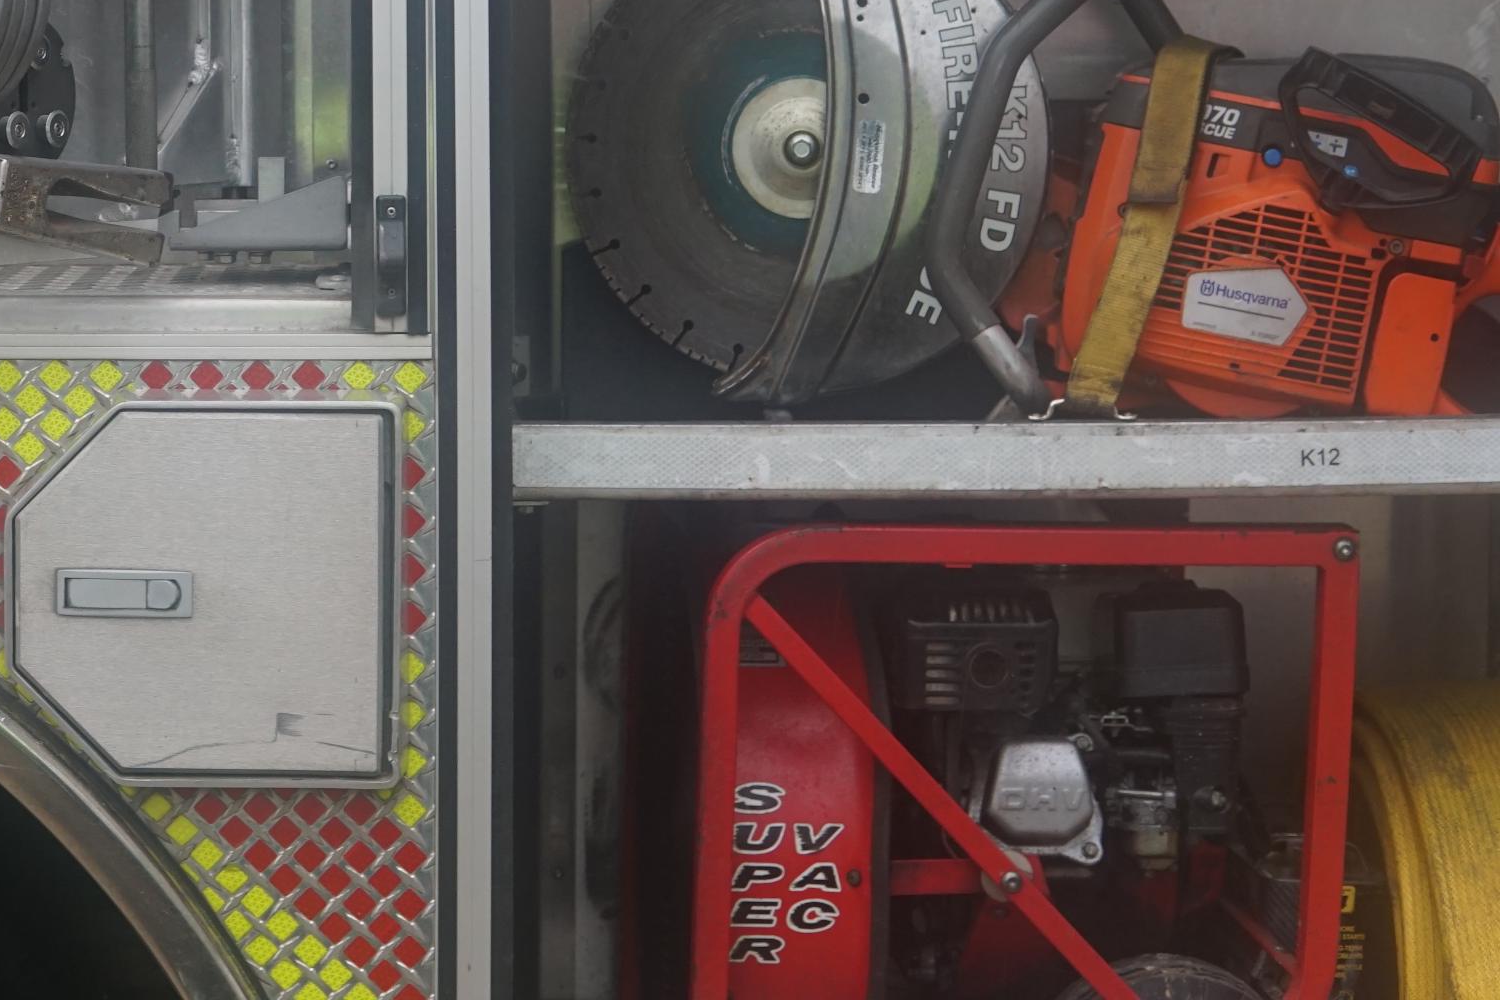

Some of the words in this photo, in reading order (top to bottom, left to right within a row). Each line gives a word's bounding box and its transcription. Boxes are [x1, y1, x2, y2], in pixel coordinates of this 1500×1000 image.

[1201, 122, 1237, 140] CUE
[980, 188, 1021, 252] FD
[1215, 283, 1288, 309] Husqvarna
[1301, 448, 1340, 466] K12
[729, 782, 786, 964] SUPER
[786, 823, 844, 933] VAC
